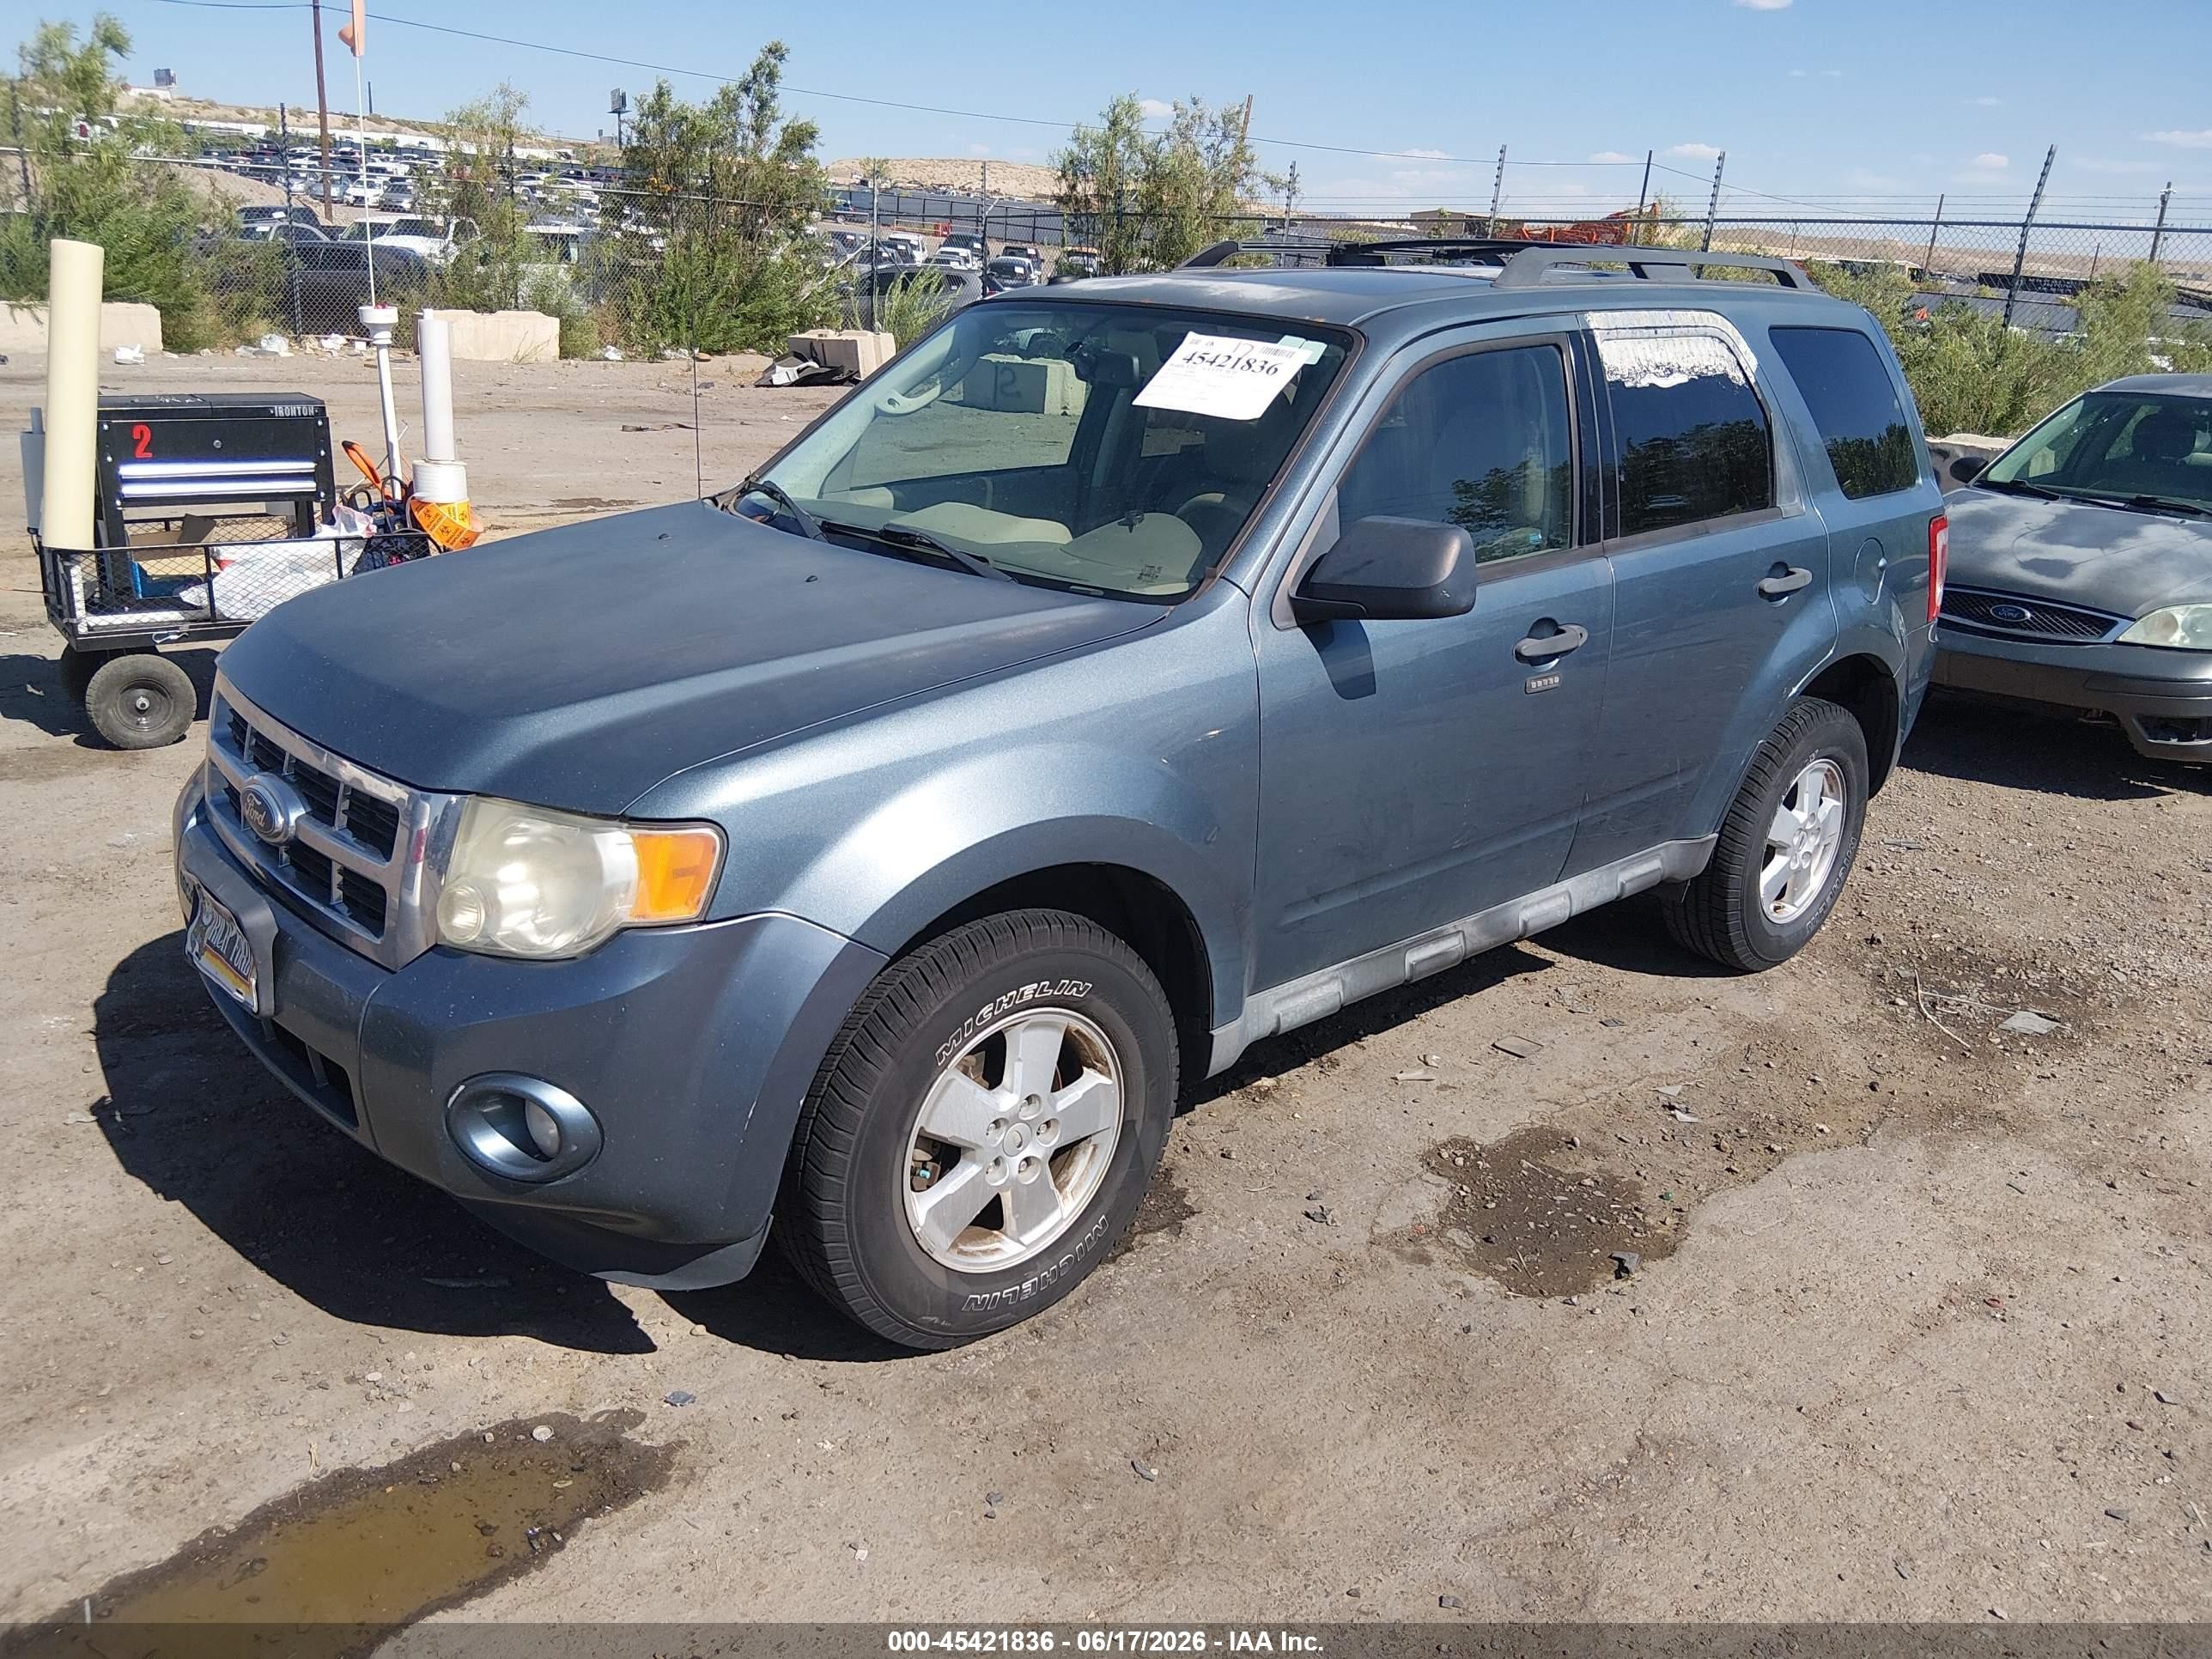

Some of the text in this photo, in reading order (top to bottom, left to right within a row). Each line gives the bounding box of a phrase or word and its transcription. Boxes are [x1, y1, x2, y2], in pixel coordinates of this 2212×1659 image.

[1182, 350, 1282, 376] 45421836
[275, 405, 314, 417] IRONTON
[132, 424, 153, 458] 2
[245, 793, 266, 827] Ford
[934, 979, 1093, 1066] MICHELIN
[961, 1214, 1109, 1312] MICHELIN
